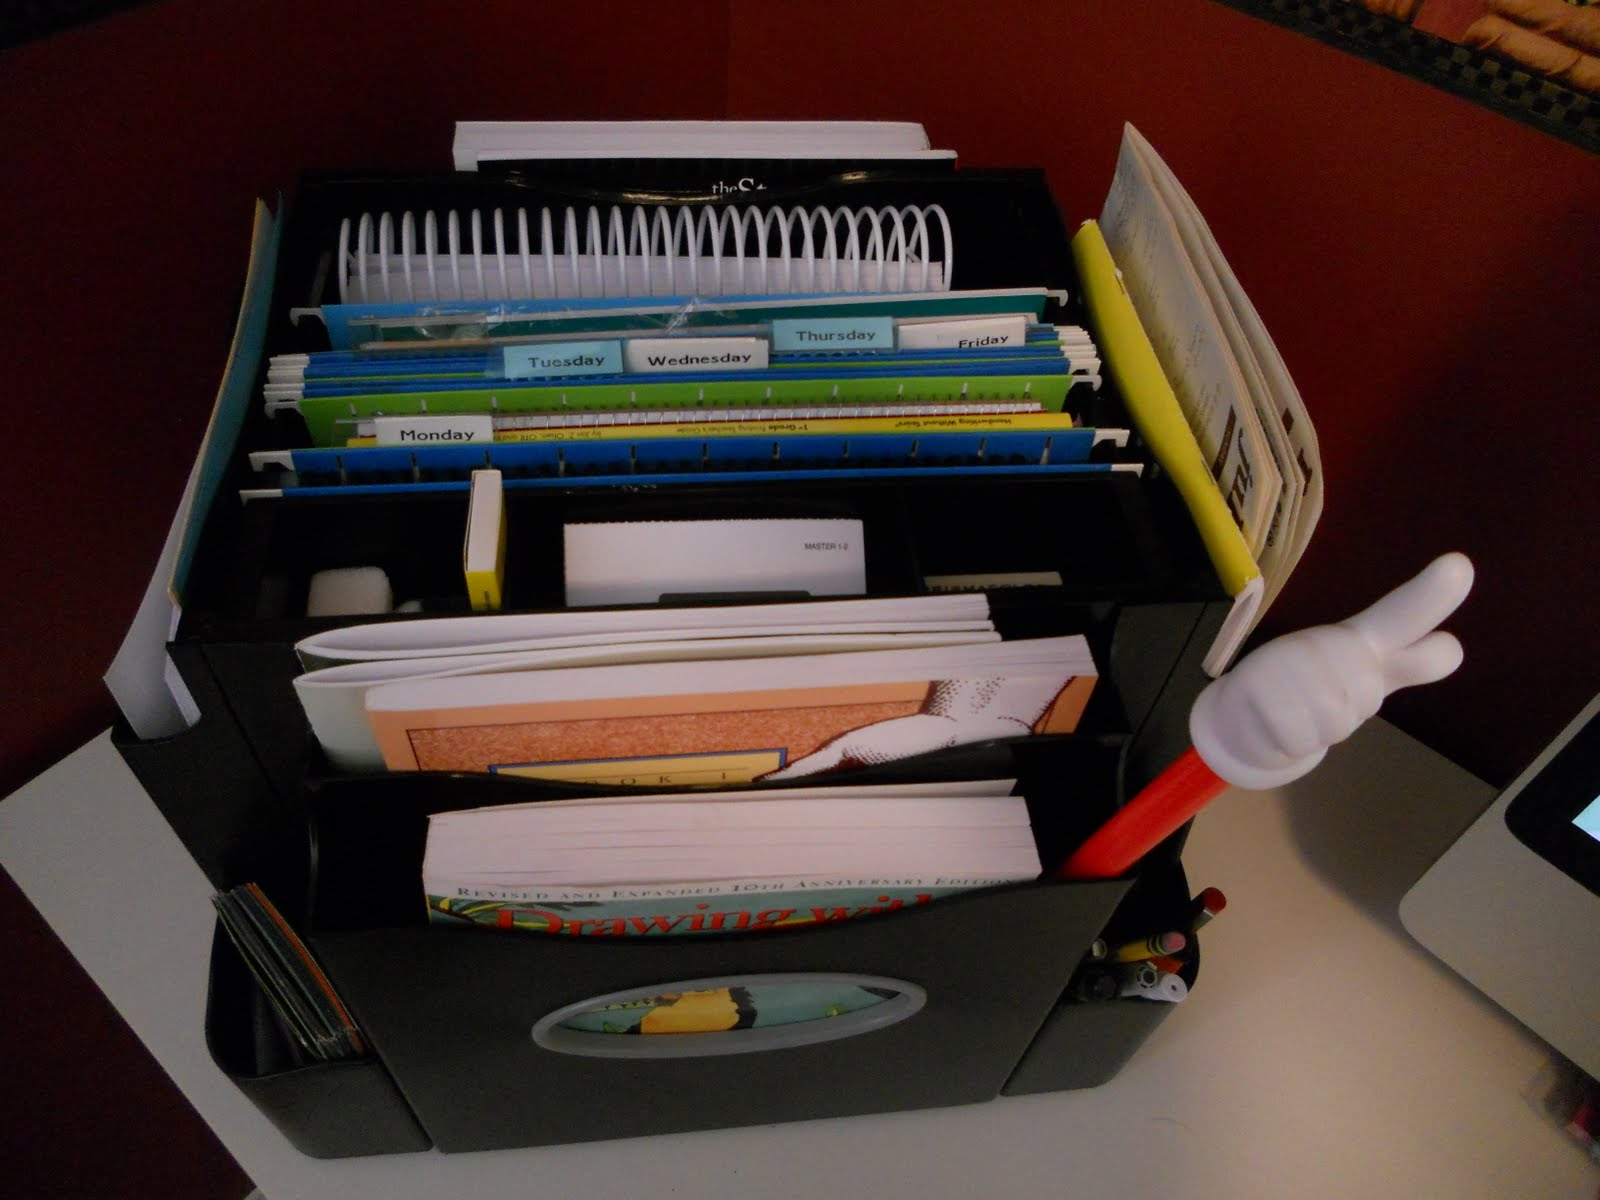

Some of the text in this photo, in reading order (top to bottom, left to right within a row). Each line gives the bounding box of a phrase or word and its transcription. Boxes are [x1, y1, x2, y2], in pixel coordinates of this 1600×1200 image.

[795, 328, 876, 344] Thursday
[958, 333, 1010, 350] Friday
[527, 354, 605, 373] Tuesday
[647, 350, 752, 368] Wednesday
[401, 428, 475, 442] Monday
[804, 542, 836, 551] MASTER
[494, 901, 798, 935] Drawing
